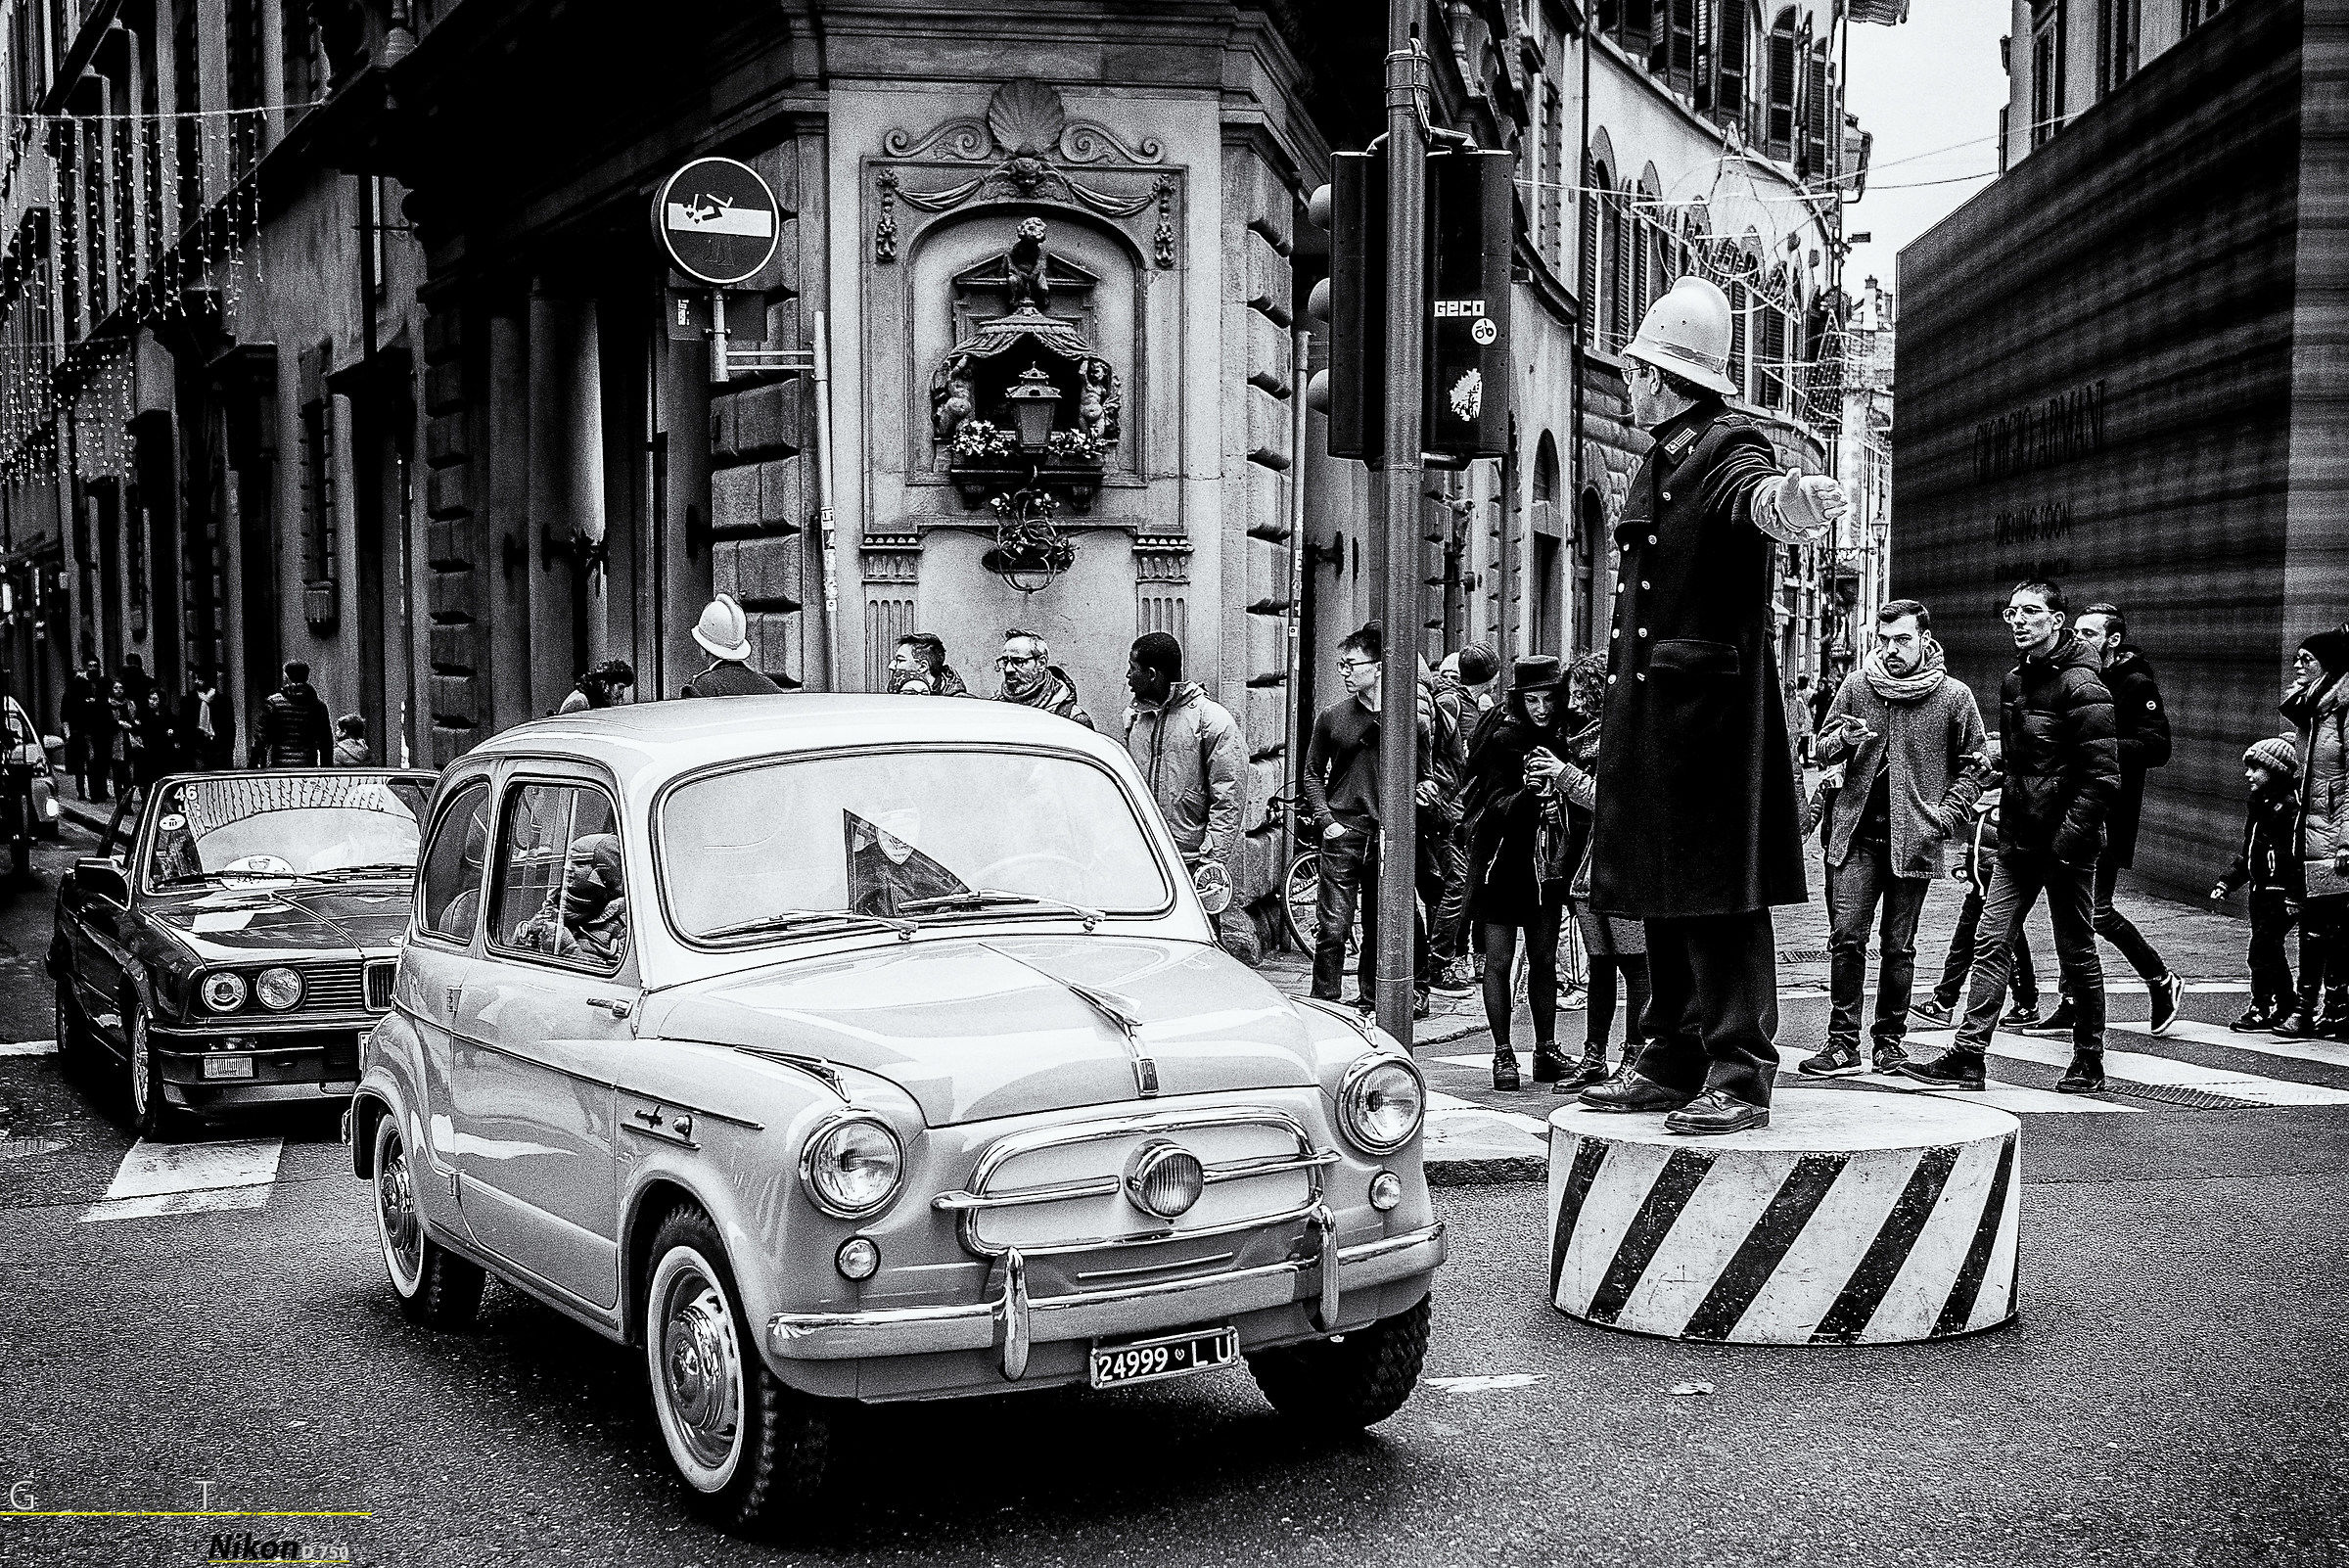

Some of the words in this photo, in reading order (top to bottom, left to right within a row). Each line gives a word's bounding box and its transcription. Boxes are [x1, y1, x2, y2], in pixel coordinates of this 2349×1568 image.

[1973, 406, 2033, 483] GIORGIO
[2039, 379, 2105, 469] ARMANI
[2040, 501, 2071, 540] SOON
[173, 785, 198, 802] 46
[1098, 1347, 1169, 1382] 24999
